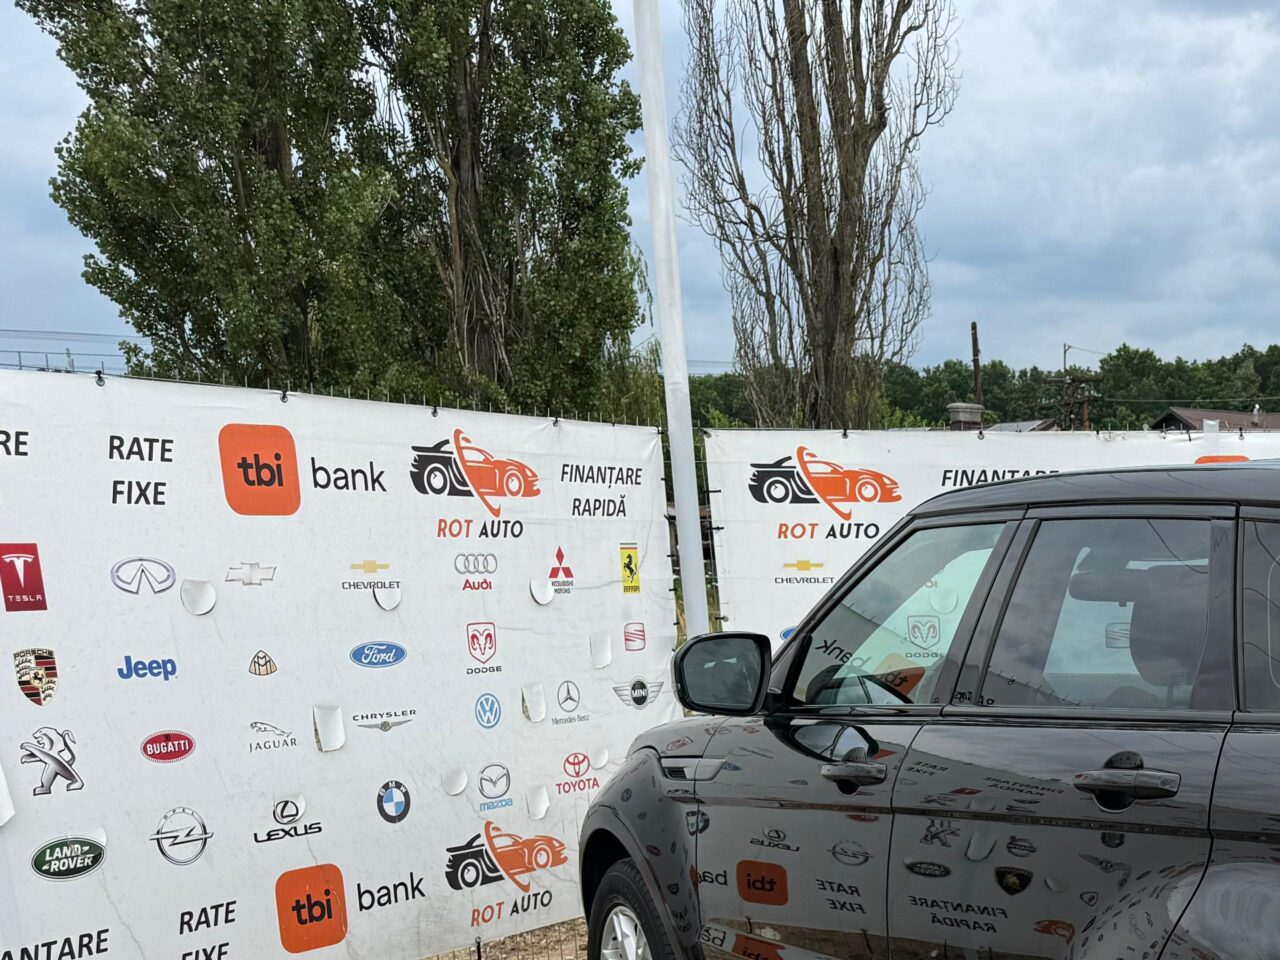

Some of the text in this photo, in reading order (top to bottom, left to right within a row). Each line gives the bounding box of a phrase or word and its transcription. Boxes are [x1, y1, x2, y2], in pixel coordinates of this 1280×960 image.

[108, 435, 174, 462] RATE
[237, 452, 387, 492] tbi bank
[560, 463, 642, 488] FINANȚARE
[111, 480, 167, 505] FIXE
[572, 496, 627, 517] RAPIDĂ
[437, 519, 524, 538] ROT AUTO
[777, 523, 880, 539] ROT AUTO
[342, 581, 400, 590] CHEVROLET
[462, 578, 492, 591] Audi
[8, 594, 43, 602] TESLA
[361, 645, 395, 663] Ford
[117, 655, 177, 680] Jeep
[466, 665, 502, 674] DODGE
[352, 709, 416, 721] CHRYSLER
[146, 740, 189, 755] BUGATTI
[249, 737, 298, 753] JAGUAR
[556, 777, 599, 795] TOYOTA
[480, 798, 513, 812] mazda
[254, 822, 322, 843] LEXUS
[50, 856, 93, 872] ROVER
[291, 872, 426, 926] tbi bank
[179, 900, 237, 935] RATE
[470, 890, 553, 928] ROT AUTO
